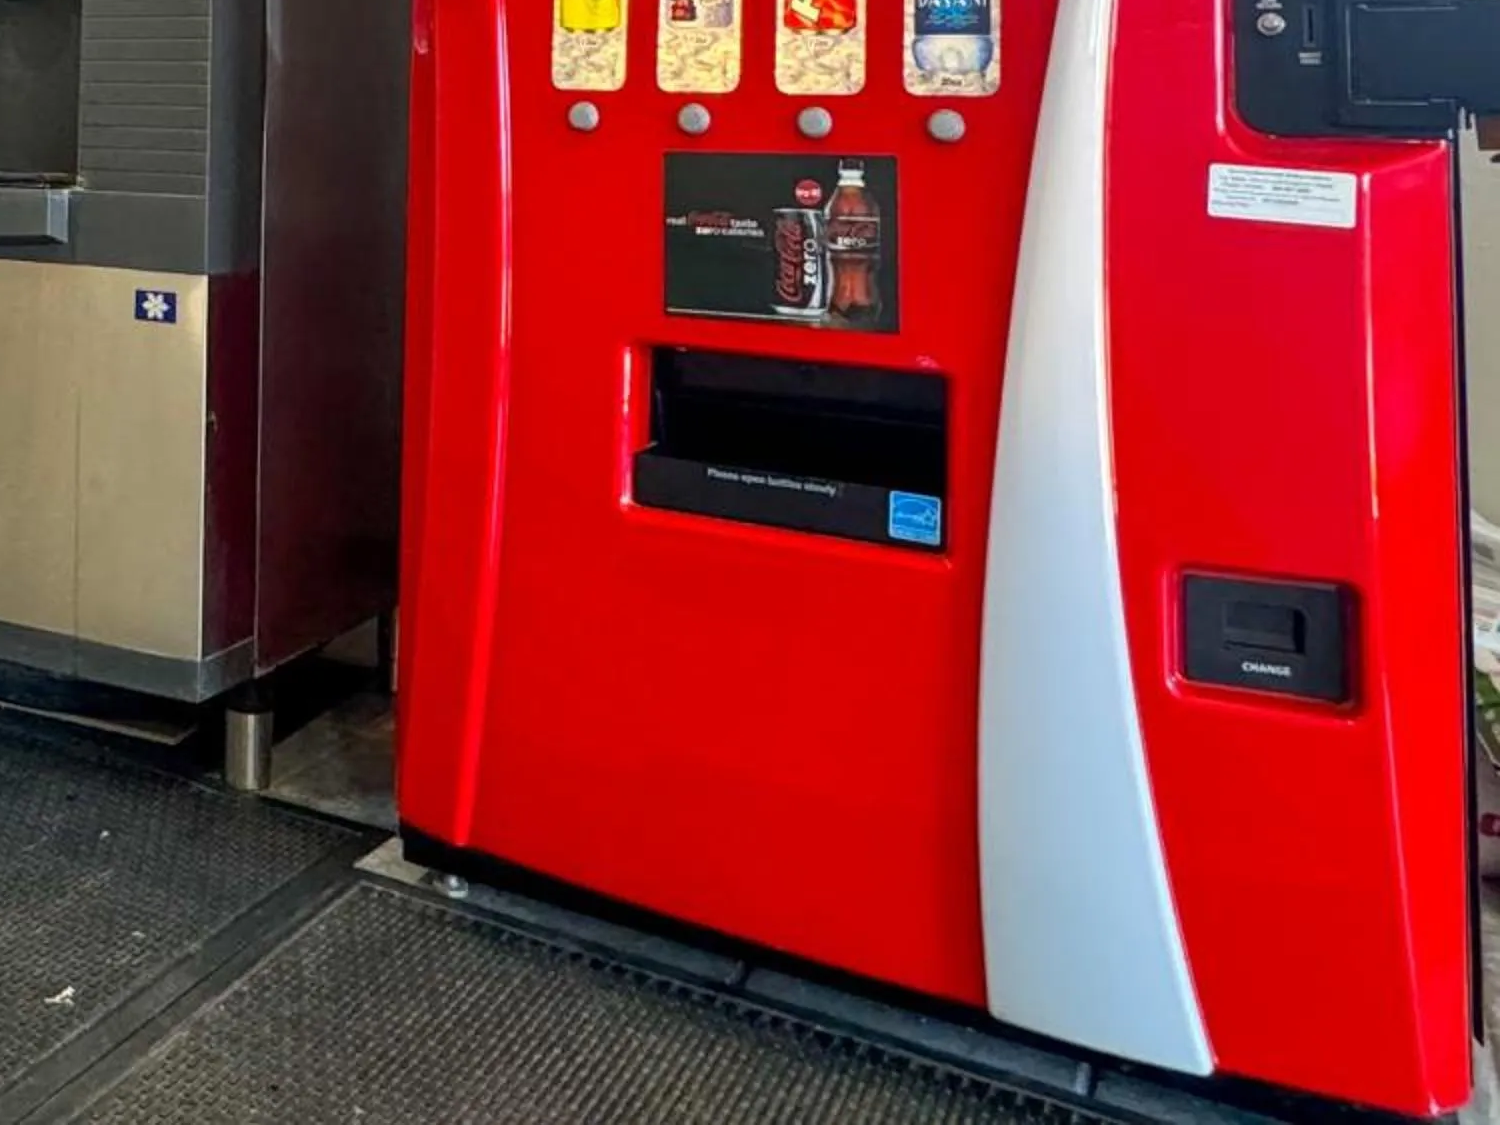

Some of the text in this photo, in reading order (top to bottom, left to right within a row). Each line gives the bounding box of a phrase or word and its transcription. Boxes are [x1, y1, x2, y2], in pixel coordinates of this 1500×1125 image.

[836, 236, 867, 248] zero
[803, 238, 817, 286] zero
[1241, 660, 1293, 678] CHANGE
